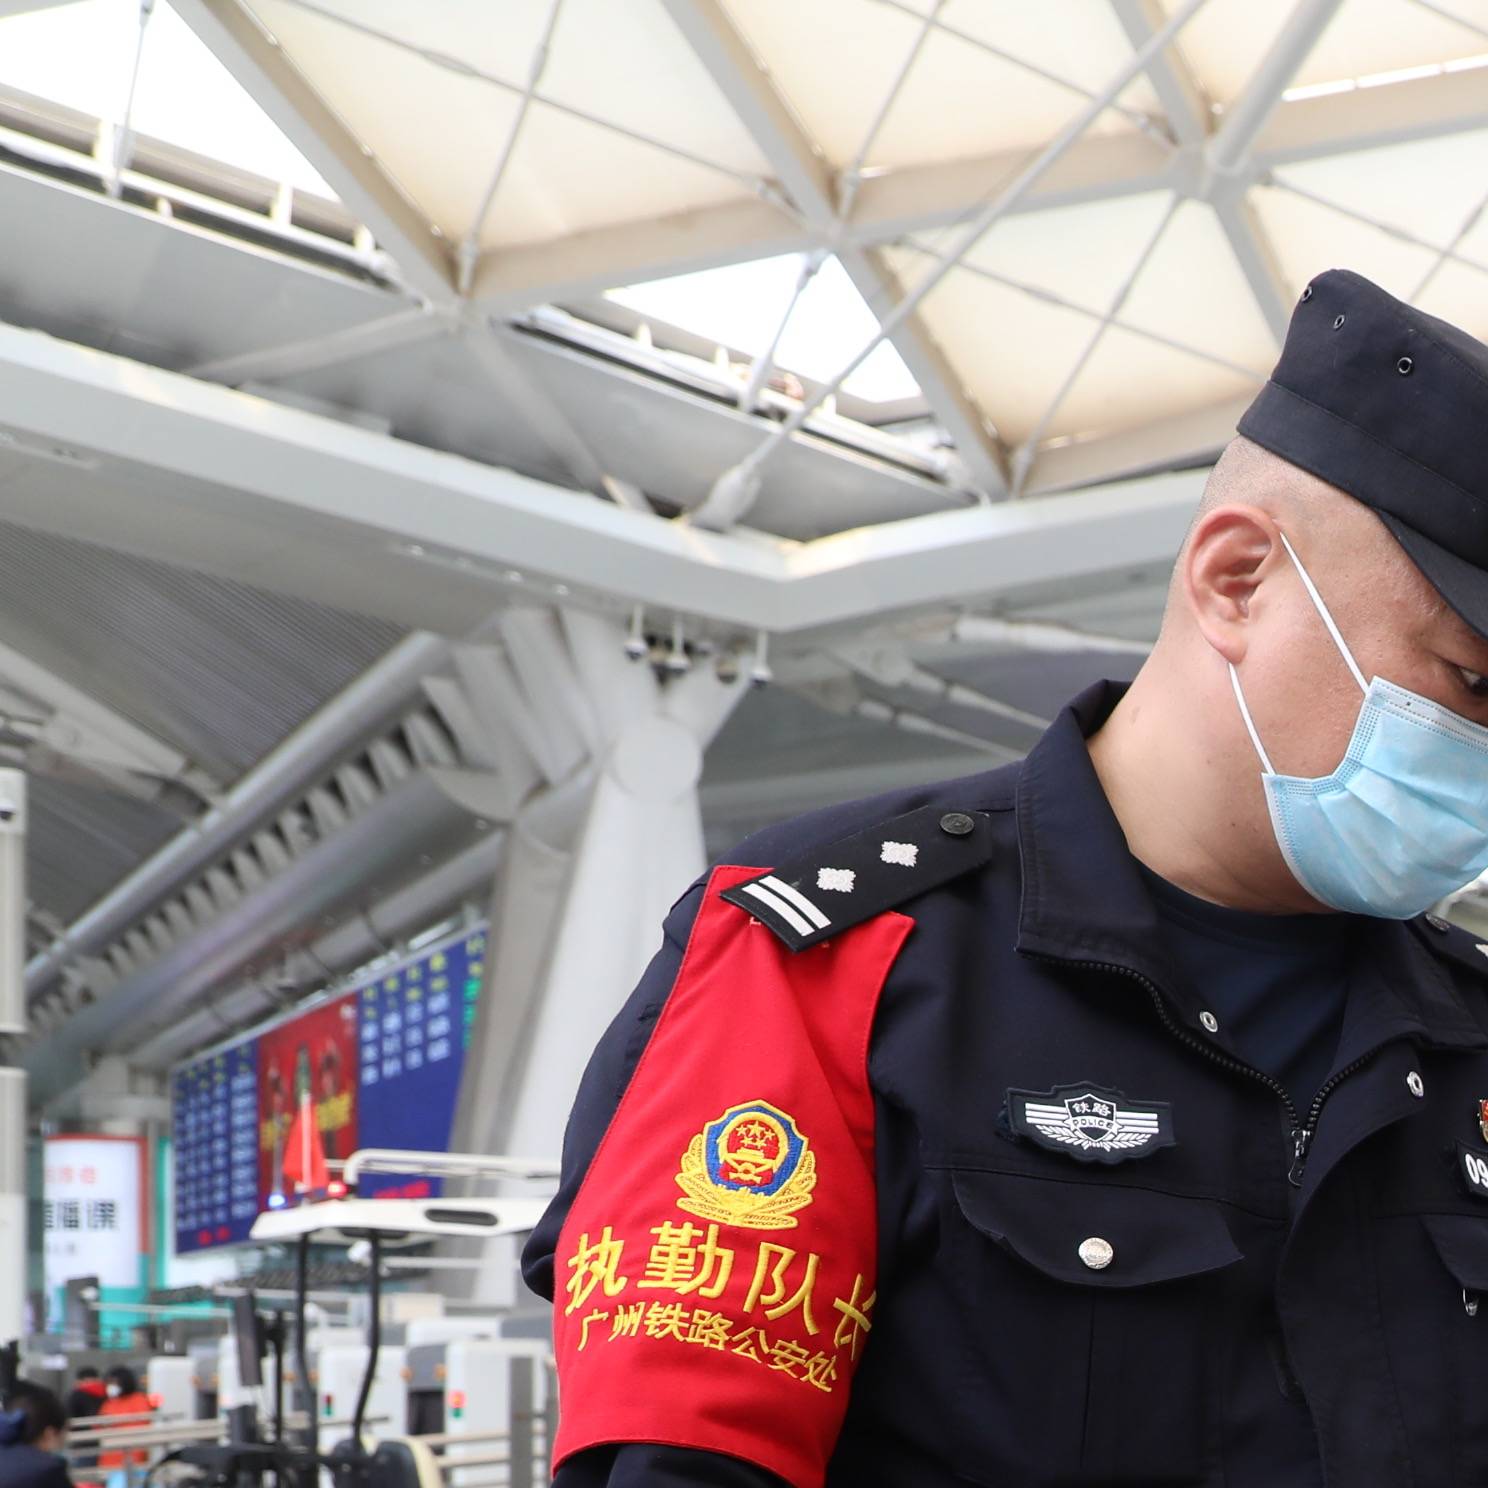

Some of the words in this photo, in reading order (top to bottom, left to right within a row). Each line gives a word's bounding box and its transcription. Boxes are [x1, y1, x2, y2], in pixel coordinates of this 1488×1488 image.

[1072, 1101, 1112, 1117] 铁路
[1072, 1118, 1114, 1130] POLICE
[565, 1220, 877, 1361] 执勤队长
[577, 1301, 837, 1392] 广州铁路公安处
